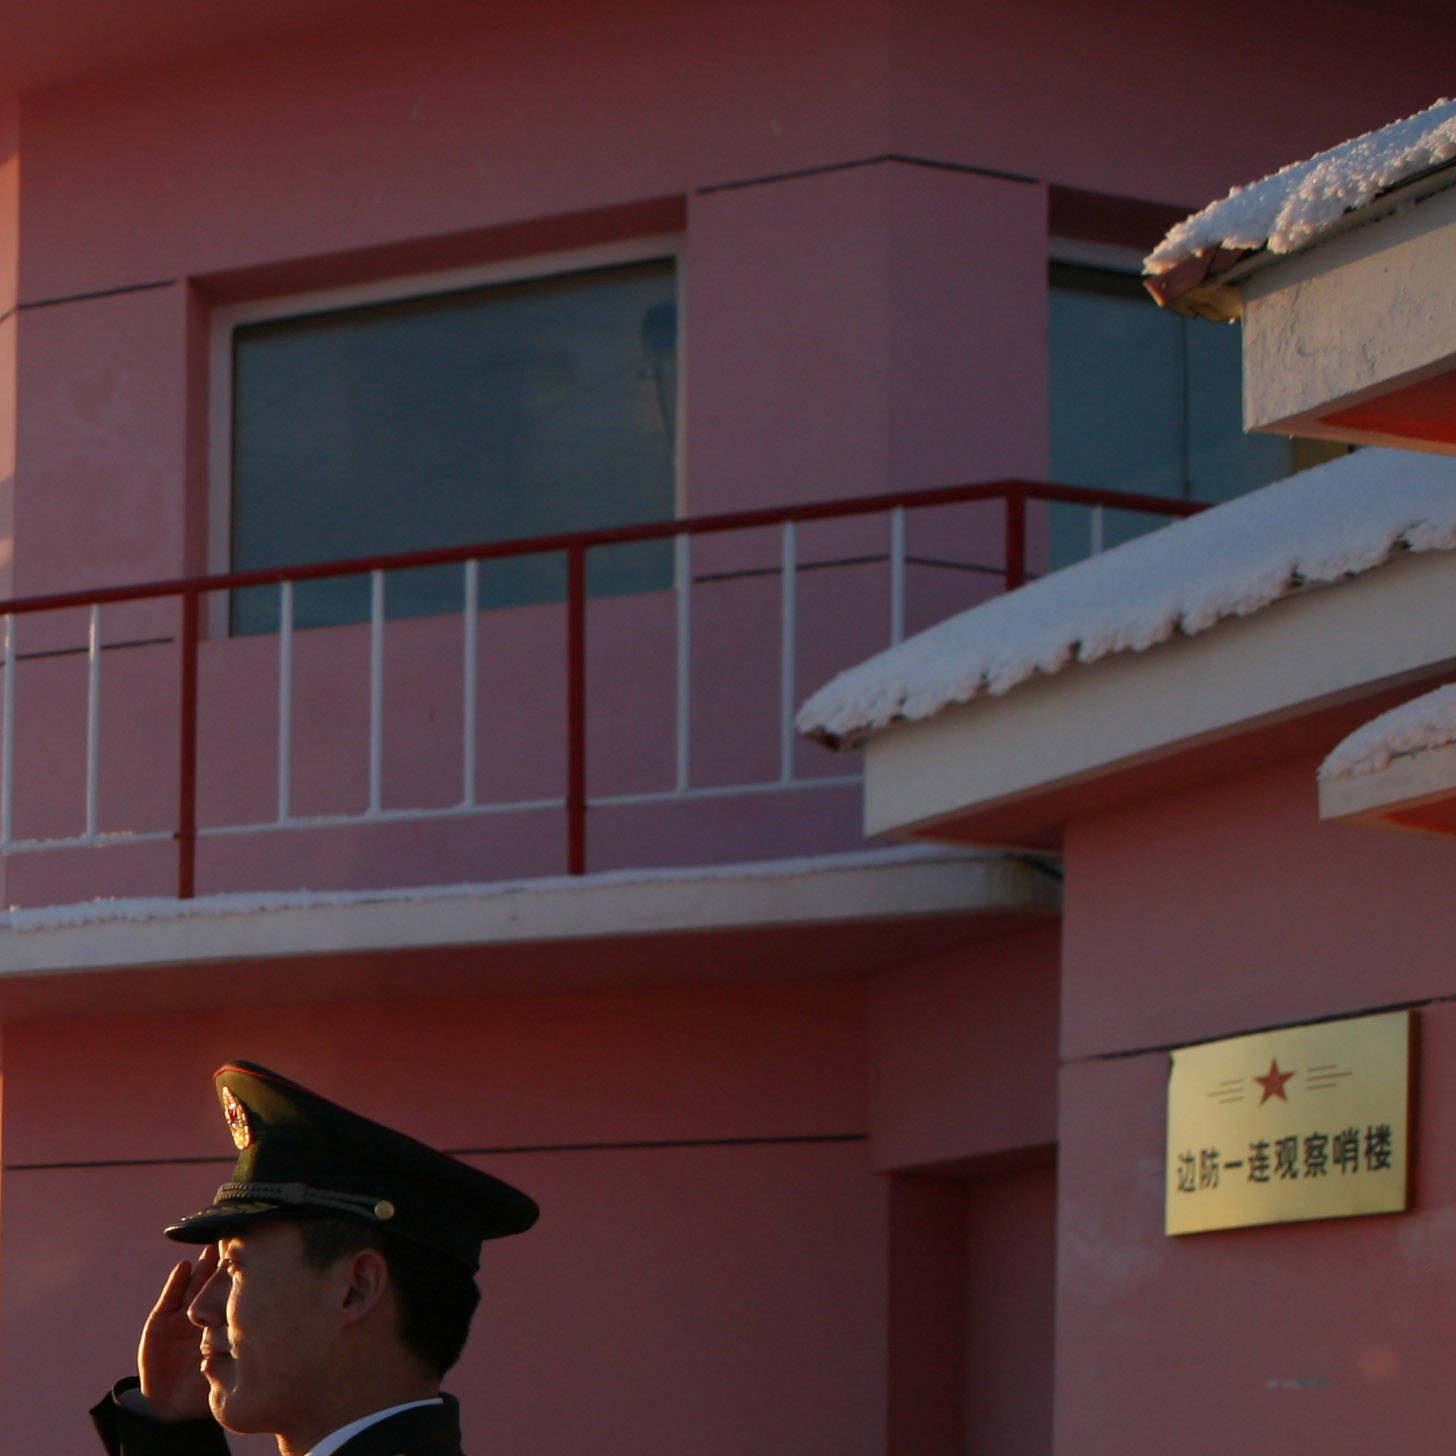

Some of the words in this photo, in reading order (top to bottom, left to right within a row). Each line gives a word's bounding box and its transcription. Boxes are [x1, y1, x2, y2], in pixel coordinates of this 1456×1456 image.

[1177, 1123, 1392, 1192] 边防一连观察哨楼
